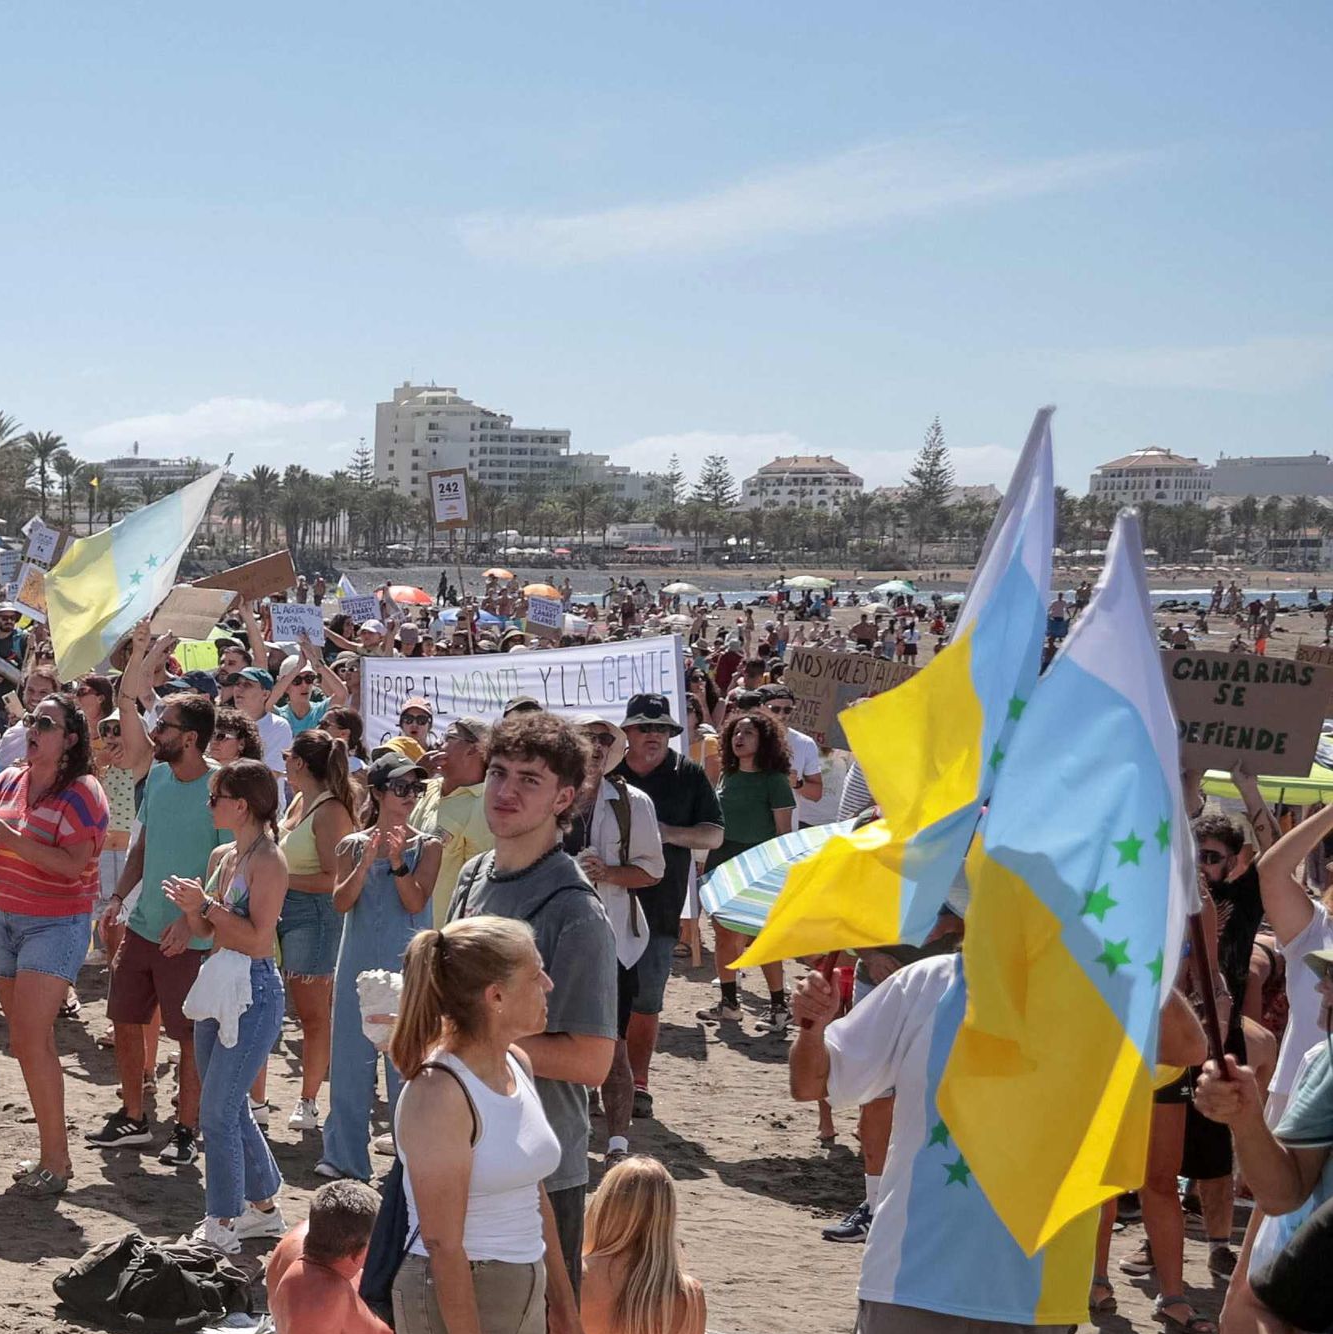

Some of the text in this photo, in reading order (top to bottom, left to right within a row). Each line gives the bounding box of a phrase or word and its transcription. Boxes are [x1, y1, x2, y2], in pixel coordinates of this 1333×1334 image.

[438, 482, 459, 494] 242
[790, 651, 822, 678] NOS
[561, 662, 593, 707] LA
[601, 650, 672, 703] GENTE
[1214, 683, 1246, 706] SE
